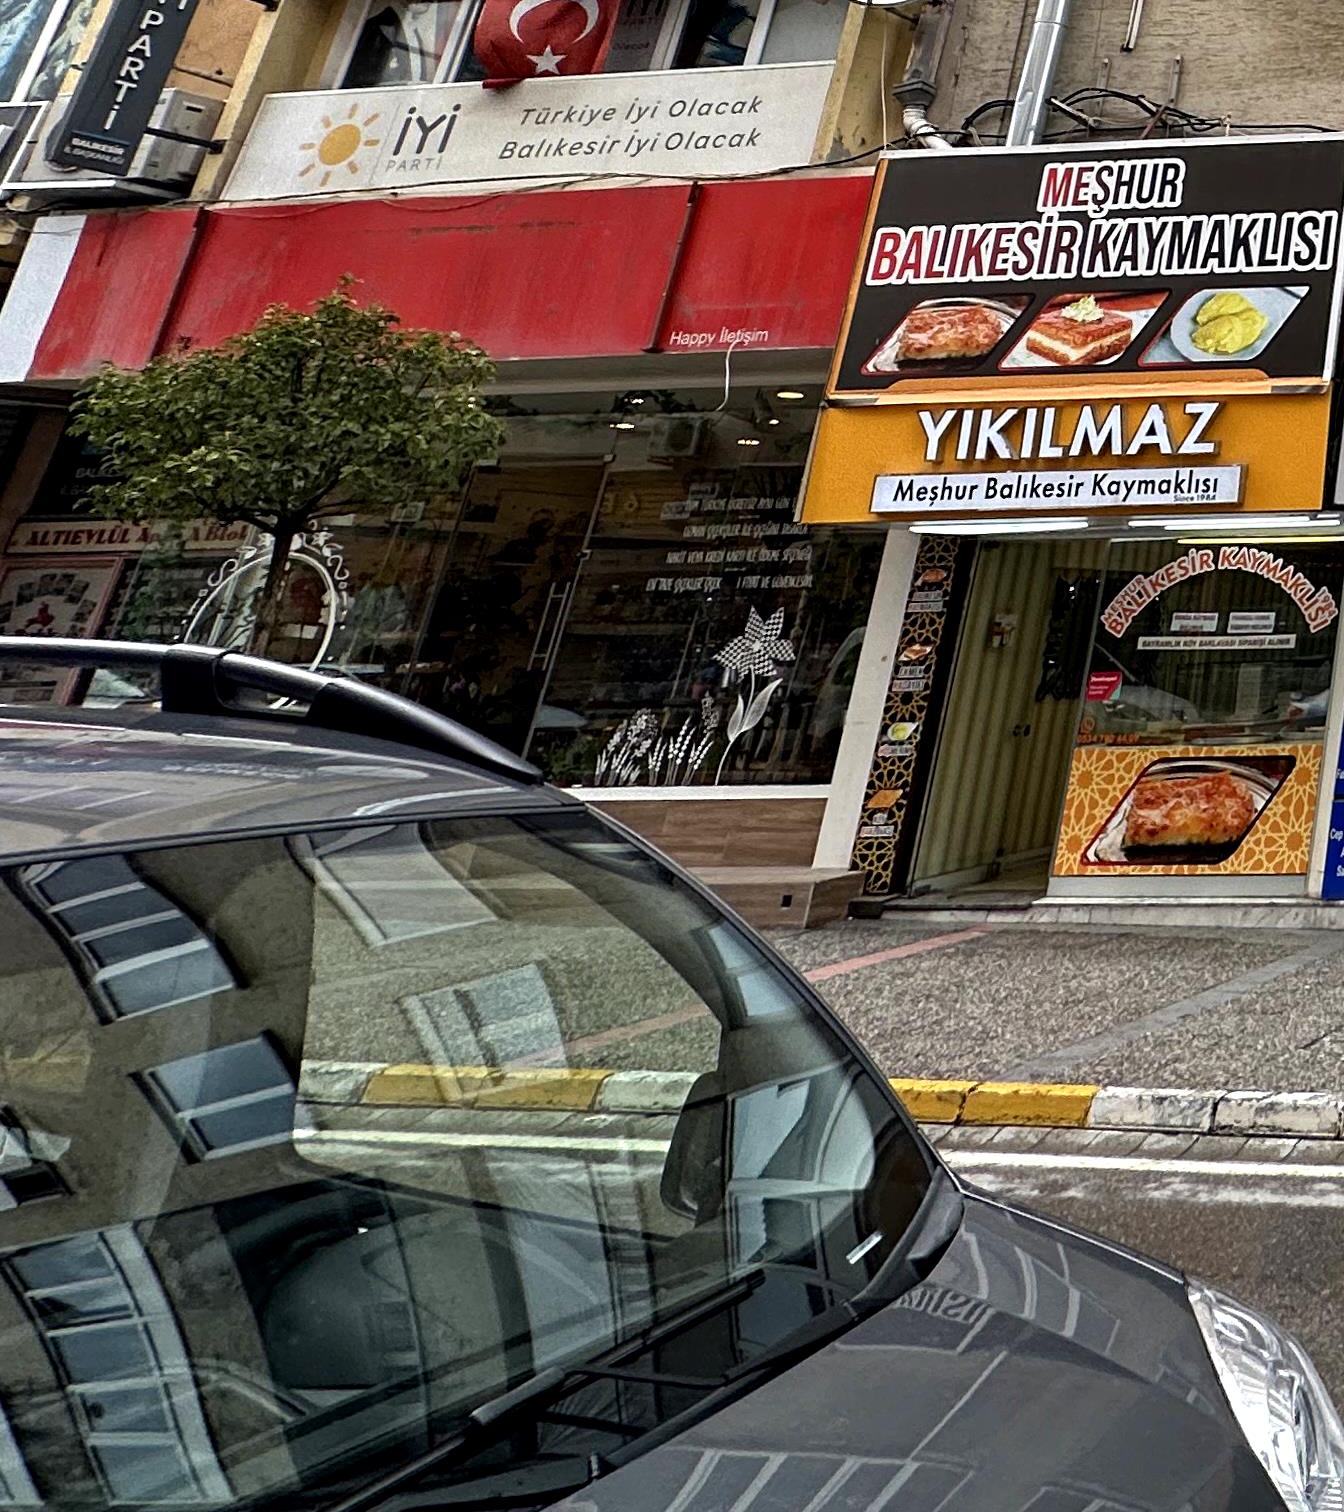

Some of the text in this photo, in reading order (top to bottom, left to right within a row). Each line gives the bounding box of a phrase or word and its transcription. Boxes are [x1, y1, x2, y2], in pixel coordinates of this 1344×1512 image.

[103, 9, 165, 131] PARTİ
[519, 95, 763, 128] Türkiye İyi Olacak
[392, 103, 463, 157] İYİ
[498, 127, 762, 161] Balıkesir İyi Olacak
[384, 155, 443, 173] PARTİ
[1037, 156, 1186, 220] MEŞHUR
[865, 209, 1339, 286] BALIKESİR KAYMAKLISI
[669, 326, 769, 349] Happy İletişim
[917, 400, 1223, 463] YIKILMAZ
[892, 471, 1219, 510] Meşhur Balıkesir Kaymaklısı
[1173, 493, 1218, 503] Since 1984
[1329, 828, 1344, 841] Cep
